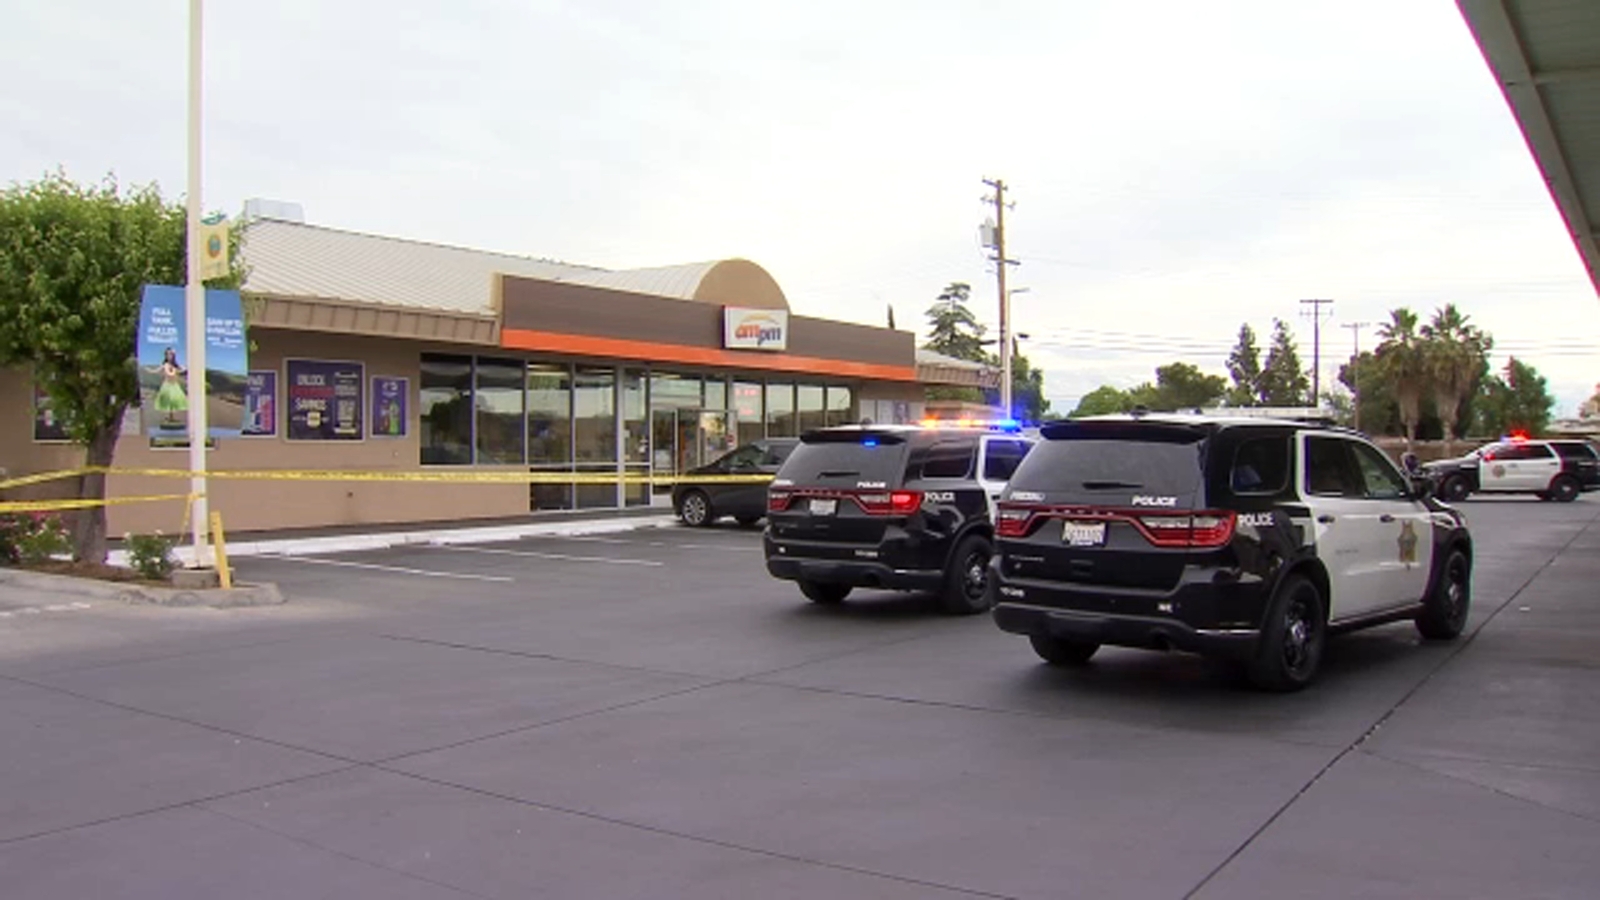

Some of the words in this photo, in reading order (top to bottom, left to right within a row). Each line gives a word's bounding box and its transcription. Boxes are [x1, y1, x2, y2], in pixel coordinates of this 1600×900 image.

[735, 323, 782, 346] ampm
[923, 491, 956, 503] POLICE
[1131, 495, 1177, 507] POLICE
[1237, 511, 1275, 526] POLICE
